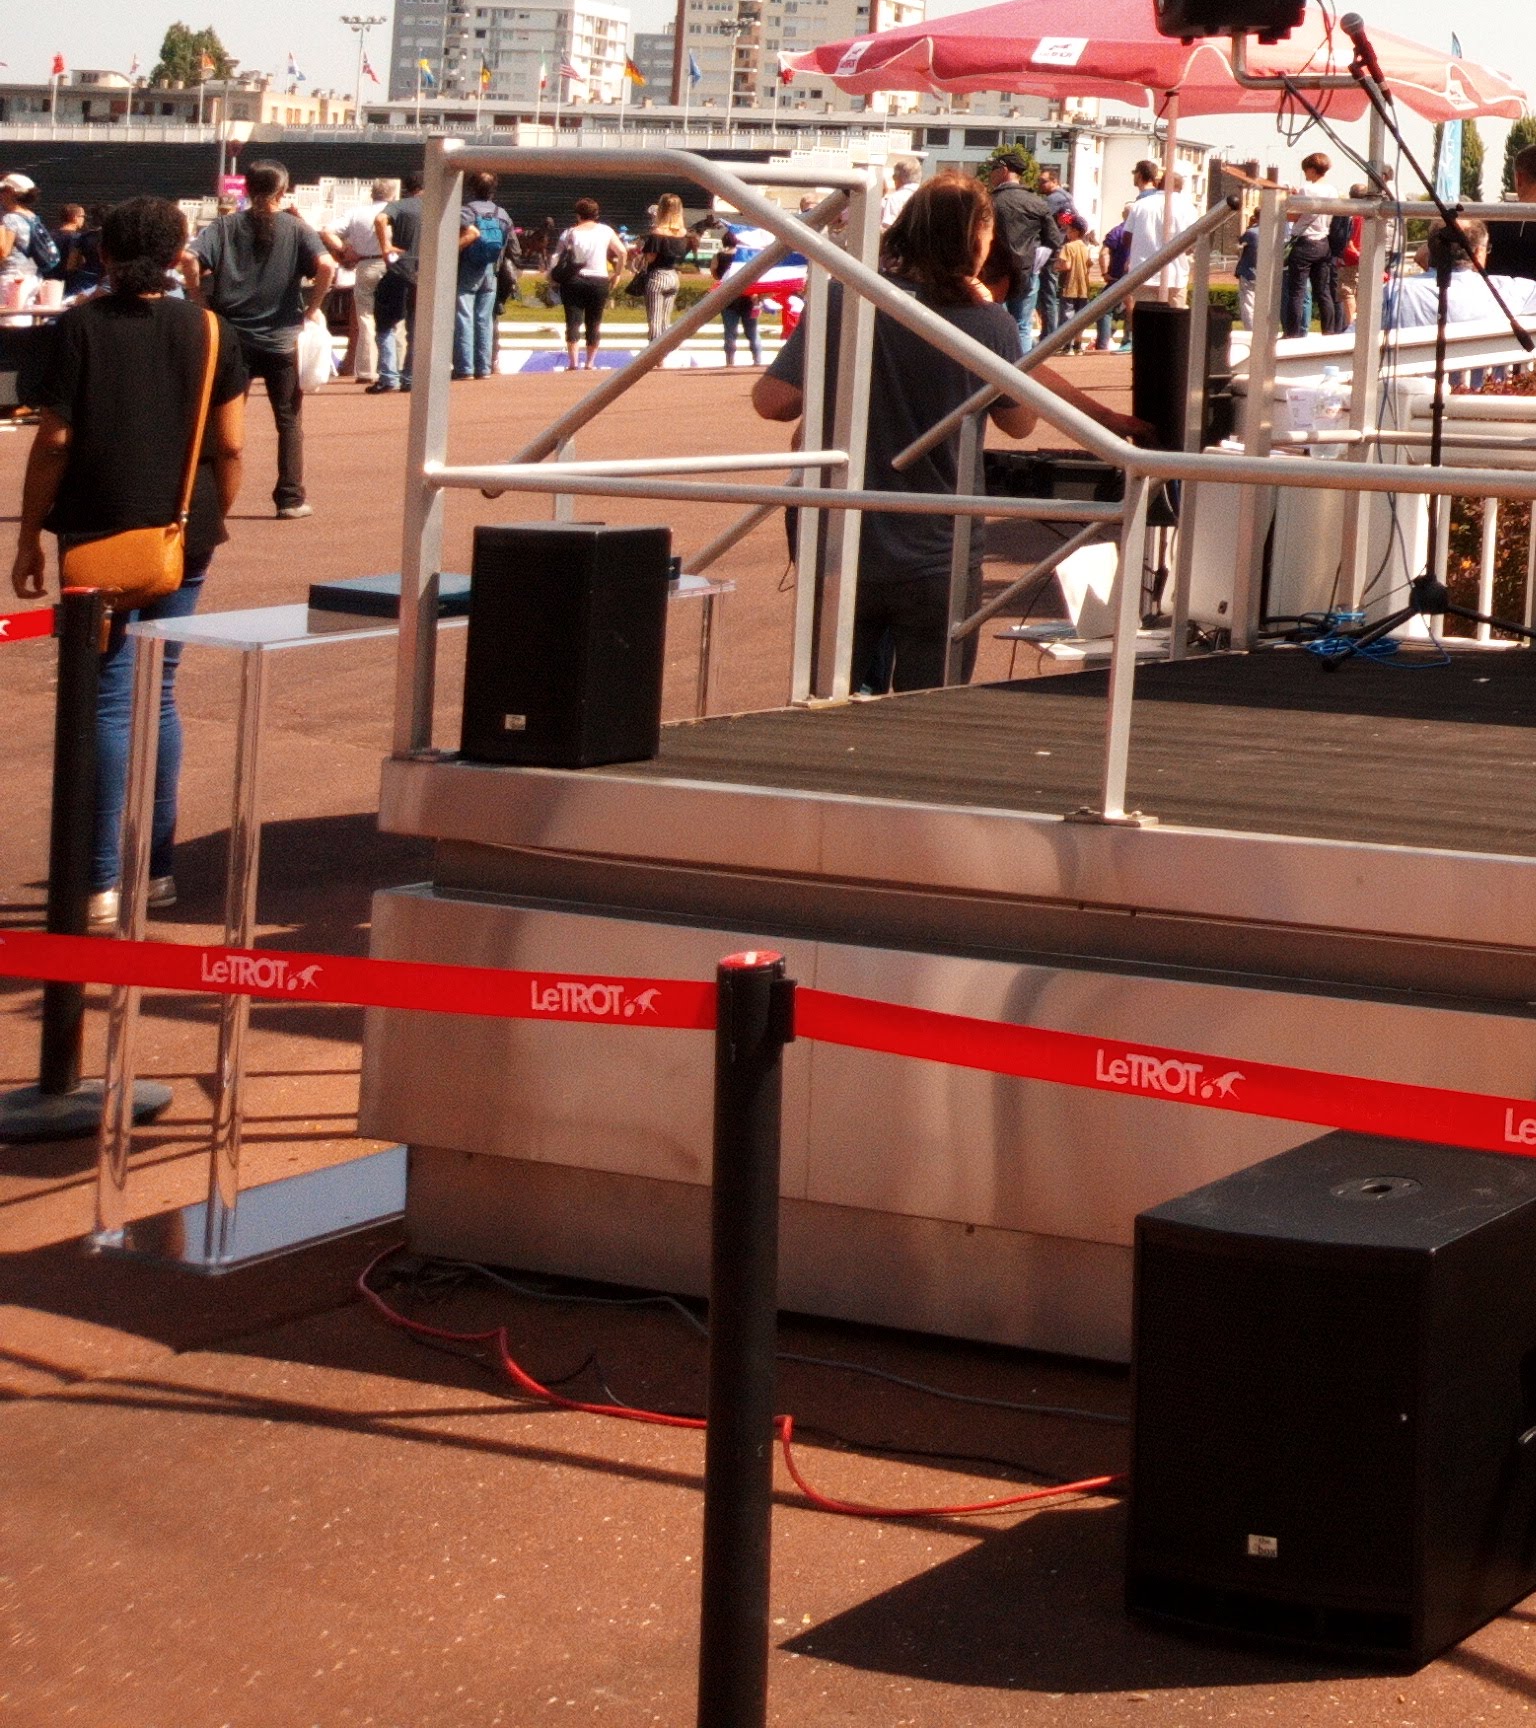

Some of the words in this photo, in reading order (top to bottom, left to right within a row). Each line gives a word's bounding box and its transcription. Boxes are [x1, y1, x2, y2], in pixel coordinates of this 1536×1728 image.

[202, 953, 287, 989] LeTROT
[530, 980, 623, 1015] LeTROT
[1096, 1049, 1203, 1097] LeTROT
